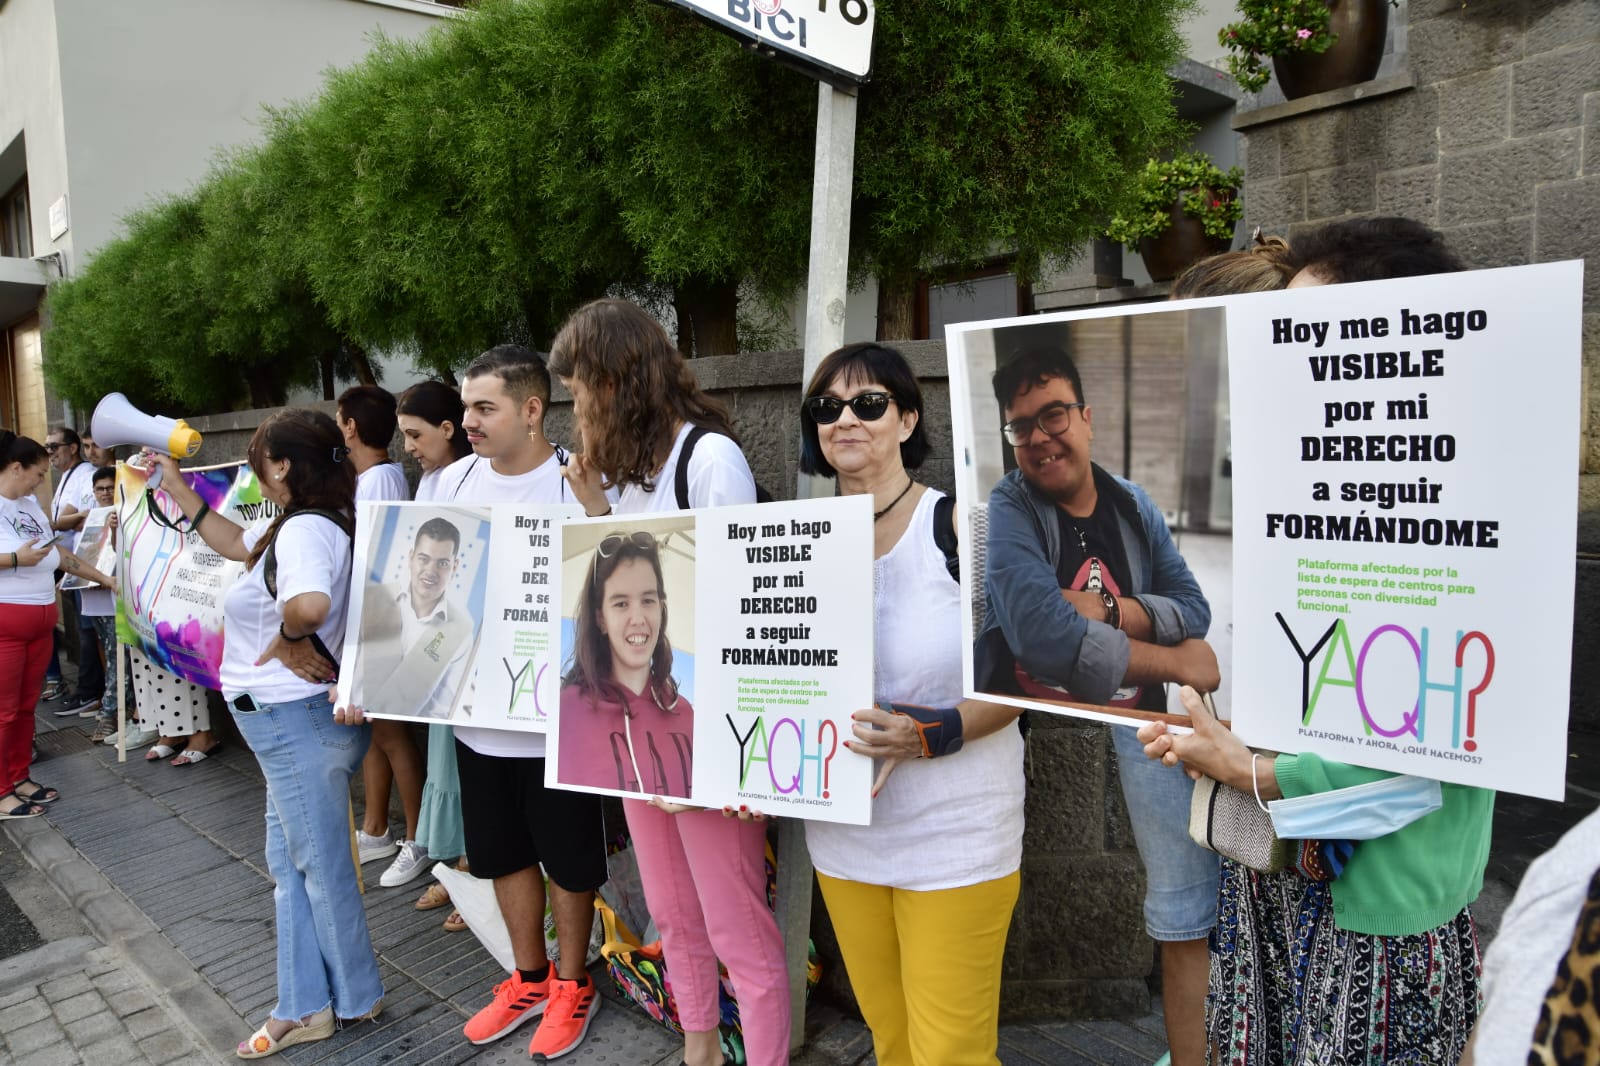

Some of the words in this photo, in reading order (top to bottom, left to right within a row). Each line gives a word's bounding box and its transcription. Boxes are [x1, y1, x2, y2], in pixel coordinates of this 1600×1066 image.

[728, 0, 806, 48] BICI
[1272, 318, 1329, 348] Hoy
[1340, 317, 1389, 339] me
[1400, 308, 1487, 340] hago
[1309, 349, 1444, 381] VISIBLE
[1324, 400, 1375, 428] por
[1387, 393, 1428, 420] mi
[1301, 434, 1456, 462] DERECHO
[1313, 482, 1330, 501] a
[1341, 477, 1442, 509] seguir
[515, 516, 539, 531] Hoy
[728, 523, 757, 542] Hoy
[761, 524, 785, 537] me
[791, 520, 832, 539] hago
[1266, 510, 1499, 548] FORMÁNDOME
[529, 535, 549, 547] VIS
[533, 556, 548, 568] po
[746, 544, 811, 563] VISIBLE
[522, 572, 549, 584] DER
[1298, 558, 1358, 572] Plataforma
[1362, 562, 1420, 576] afectados
[1424, 568, 1443, 578] por
[1446, 567, 1458, 578] la
[753, 575, 778, 592] por
[784, 571, 804, 587] mi
[1298, 572, 1320, 584] lista
[1323, 574, 1337, 584] de
[1340, 577, 1378, 588] espera
[1381, 578, 1396, 589] de
[1398, 580, 1444, 592] centros
[1447, 583, 1475, 595] para
[525, 594, 532, 603] a
[536, 594, 549, 604] se
[740, 596, 817, 614] DERECHO
[1298, 587, 1348, 600] personas
[1350, 592, 1372, 601] con
[1375, 592, 1437, 606] diversidad
[1298, 600, 1352, 614] funcional.
[503, 607, 548, 622] FORMÁ
[746, 627, 755, 639] a
[760, 623, 811, 644] seguir
[722, 645, 838, 666] FORMÁNDOME
[1275, 612, 1495, 752] YAQH?
[726, 713, 838, 799] YAQH?
[1298, 727, 1354, 744] PLATAFORMA
[1365, 738, 1400, 752] AHORA,
[1429, 751, 1482, 765] HACEMOS?
